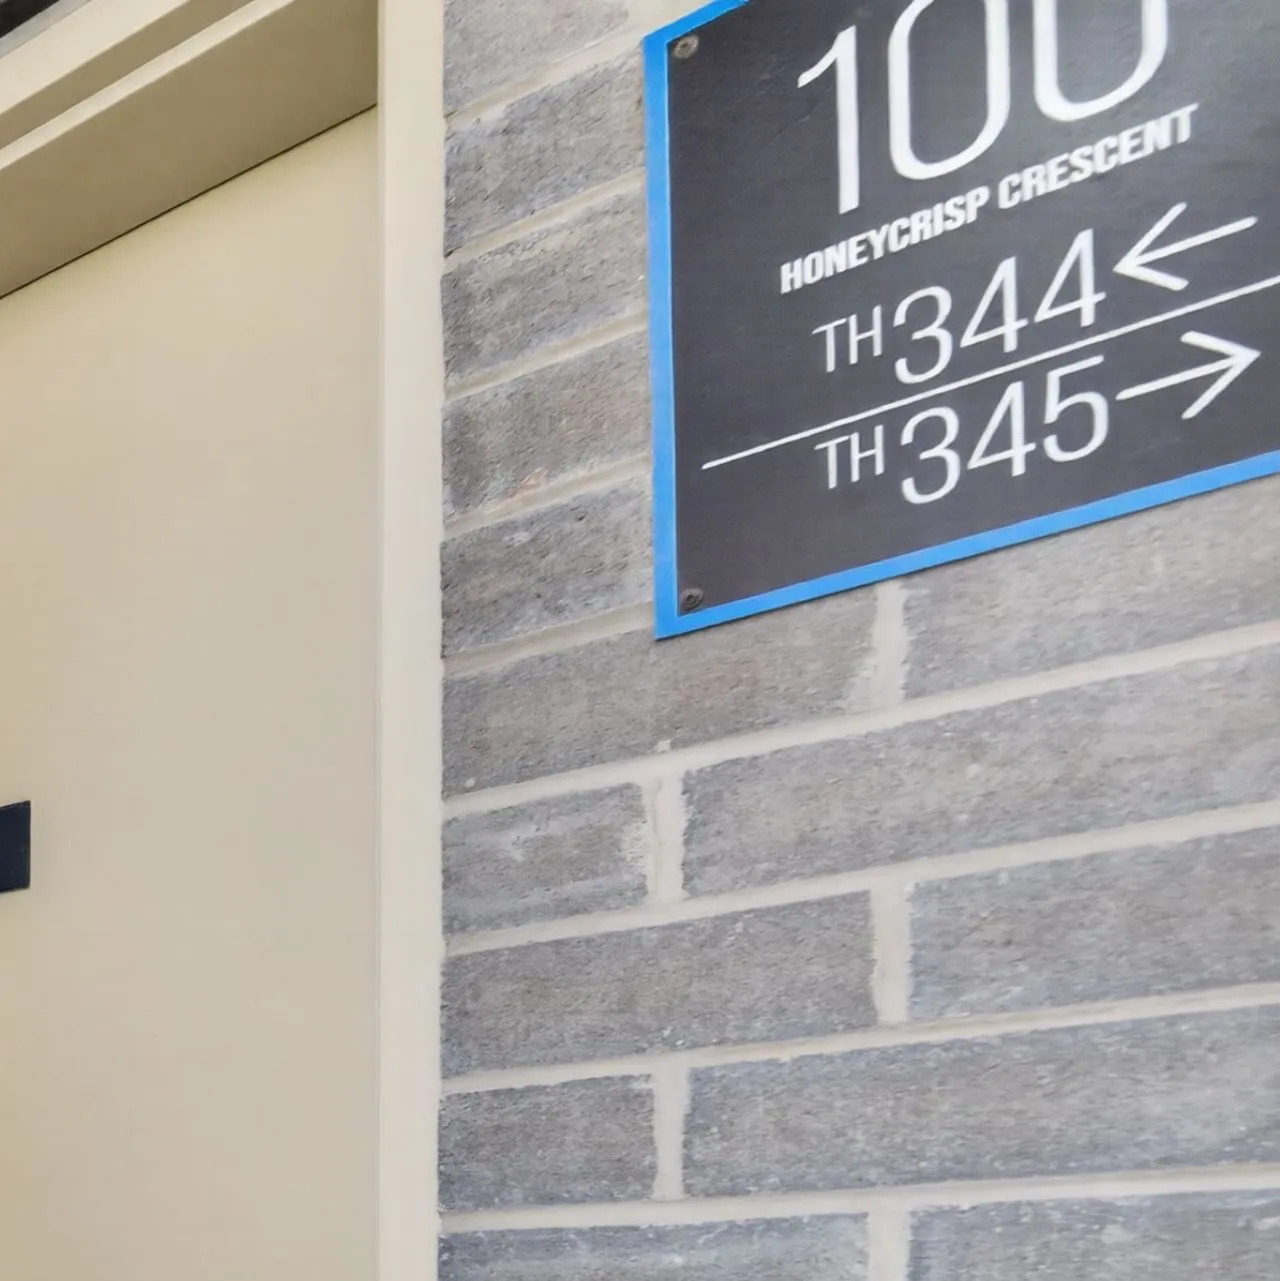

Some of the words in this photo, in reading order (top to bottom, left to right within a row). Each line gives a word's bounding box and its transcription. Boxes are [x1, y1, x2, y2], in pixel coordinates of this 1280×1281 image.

[797, 0, 1168, 214] 100
[780, 186, 991, 295] HONEYCRISP
[998, 103, 1200, 209] CRESCENT
[811, 228, 1107, 386] TH344
[813, 354, 1110, 505] TH345
